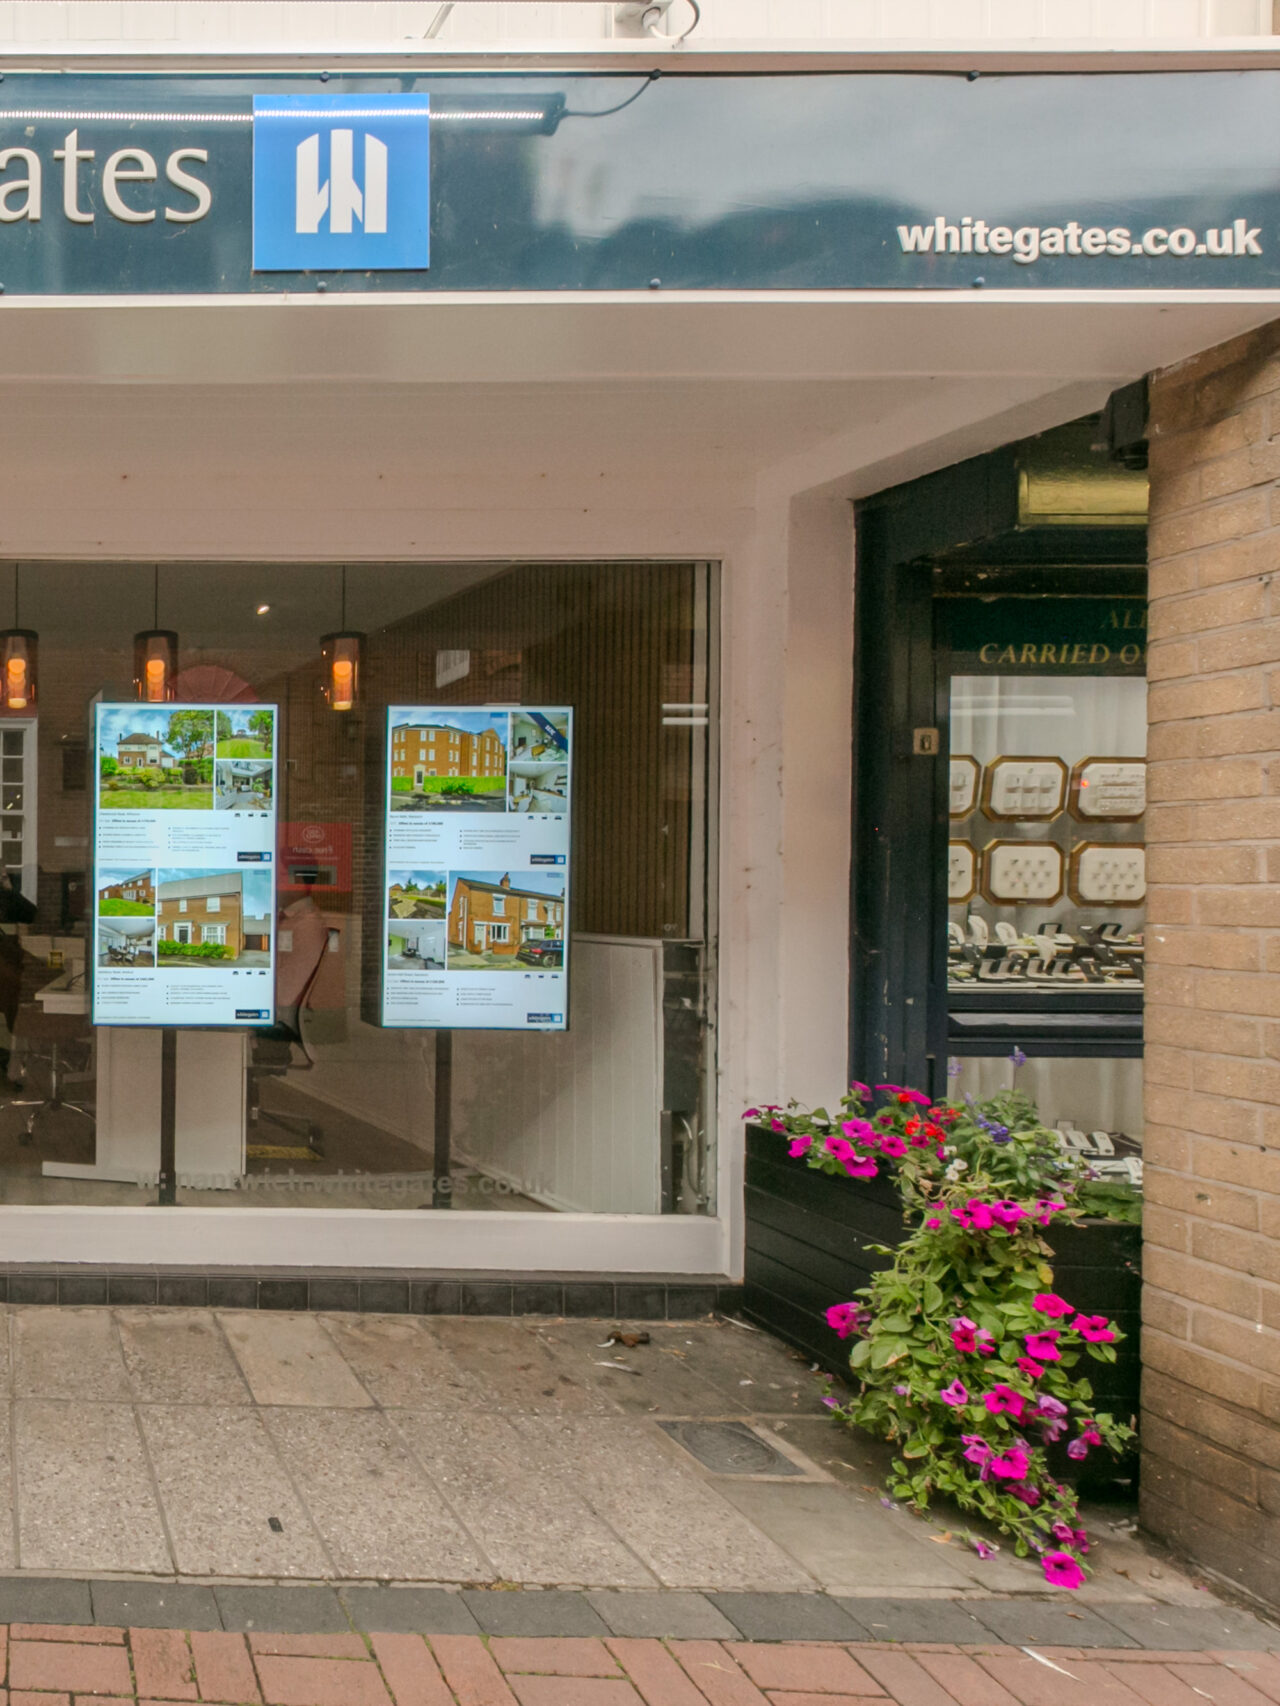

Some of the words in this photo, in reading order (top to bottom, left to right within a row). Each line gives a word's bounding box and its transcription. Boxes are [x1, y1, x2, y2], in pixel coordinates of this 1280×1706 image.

[896, 215, 1263, 265] whitegates.co.uk
[978, 642, 1111, 665] CARRIED
[1119, 642, 1147, 665] O
